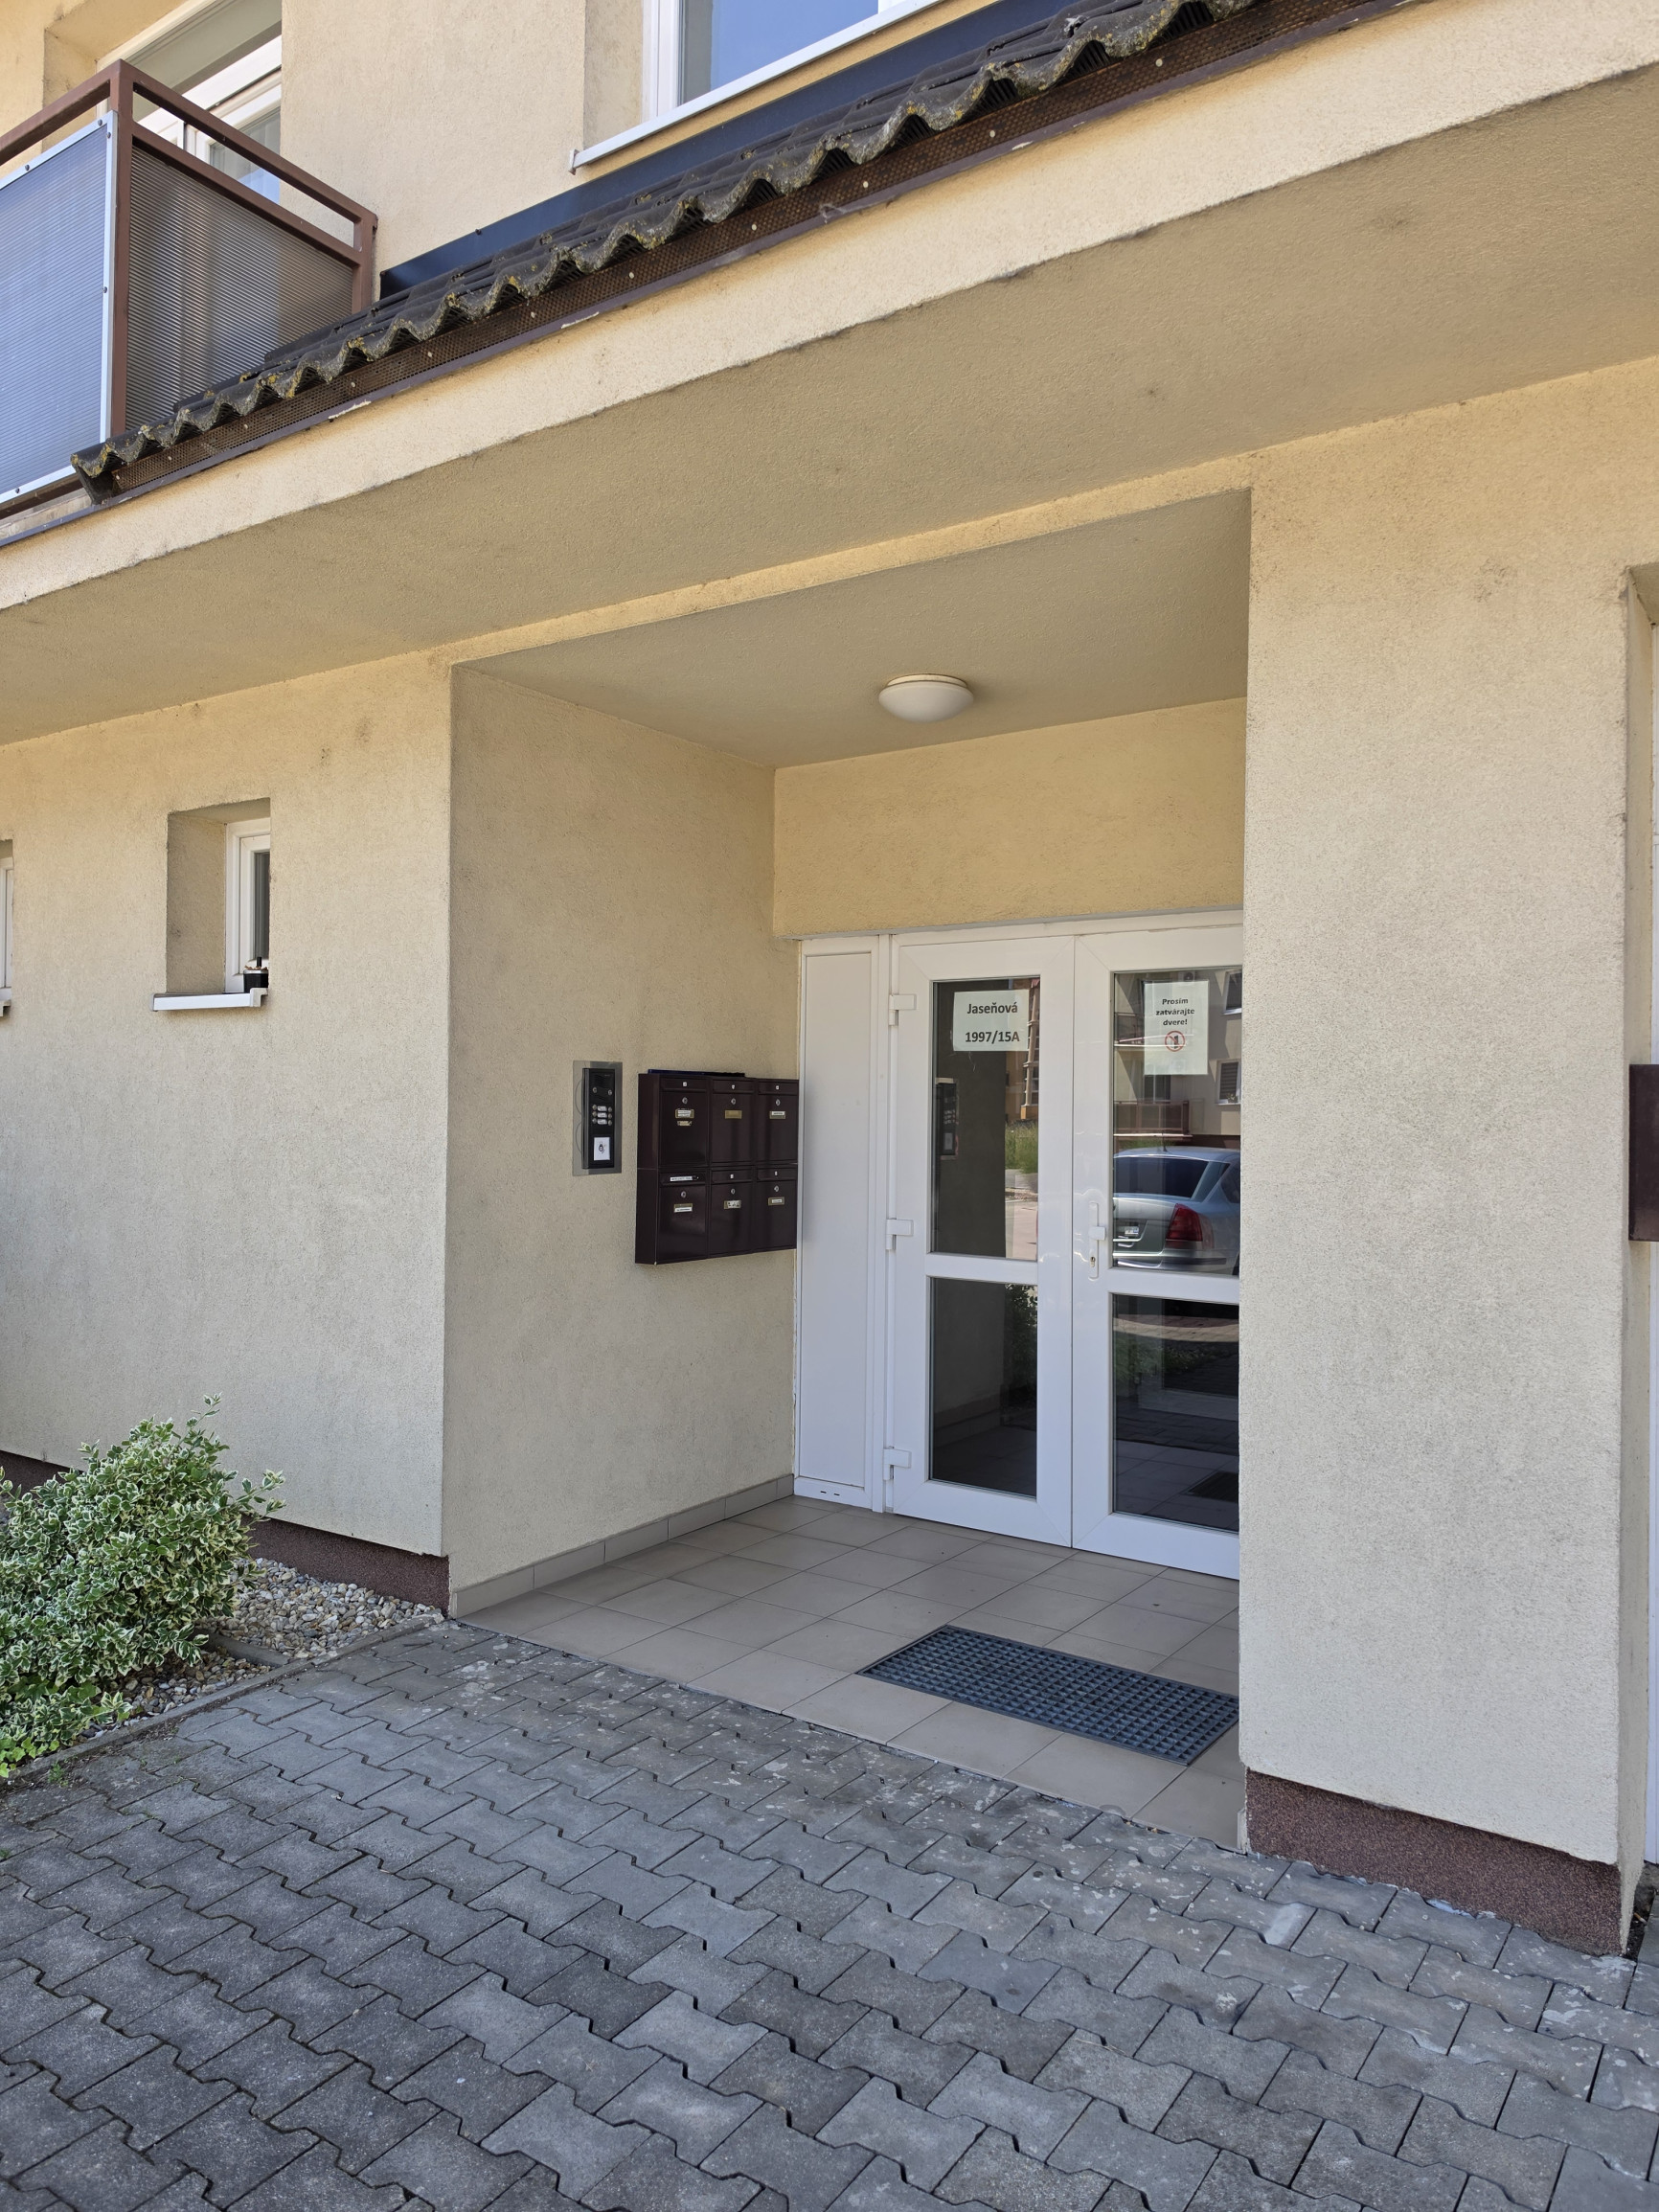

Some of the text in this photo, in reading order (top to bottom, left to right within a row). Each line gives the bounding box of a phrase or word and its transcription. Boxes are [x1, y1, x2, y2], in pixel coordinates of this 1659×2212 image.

[966, 1001, 1018, 1015] Jaseňová
[1155, 1008, 1195, 1016] zatvárajte
[965, 1030, 1020, 1044] 1997/15A
